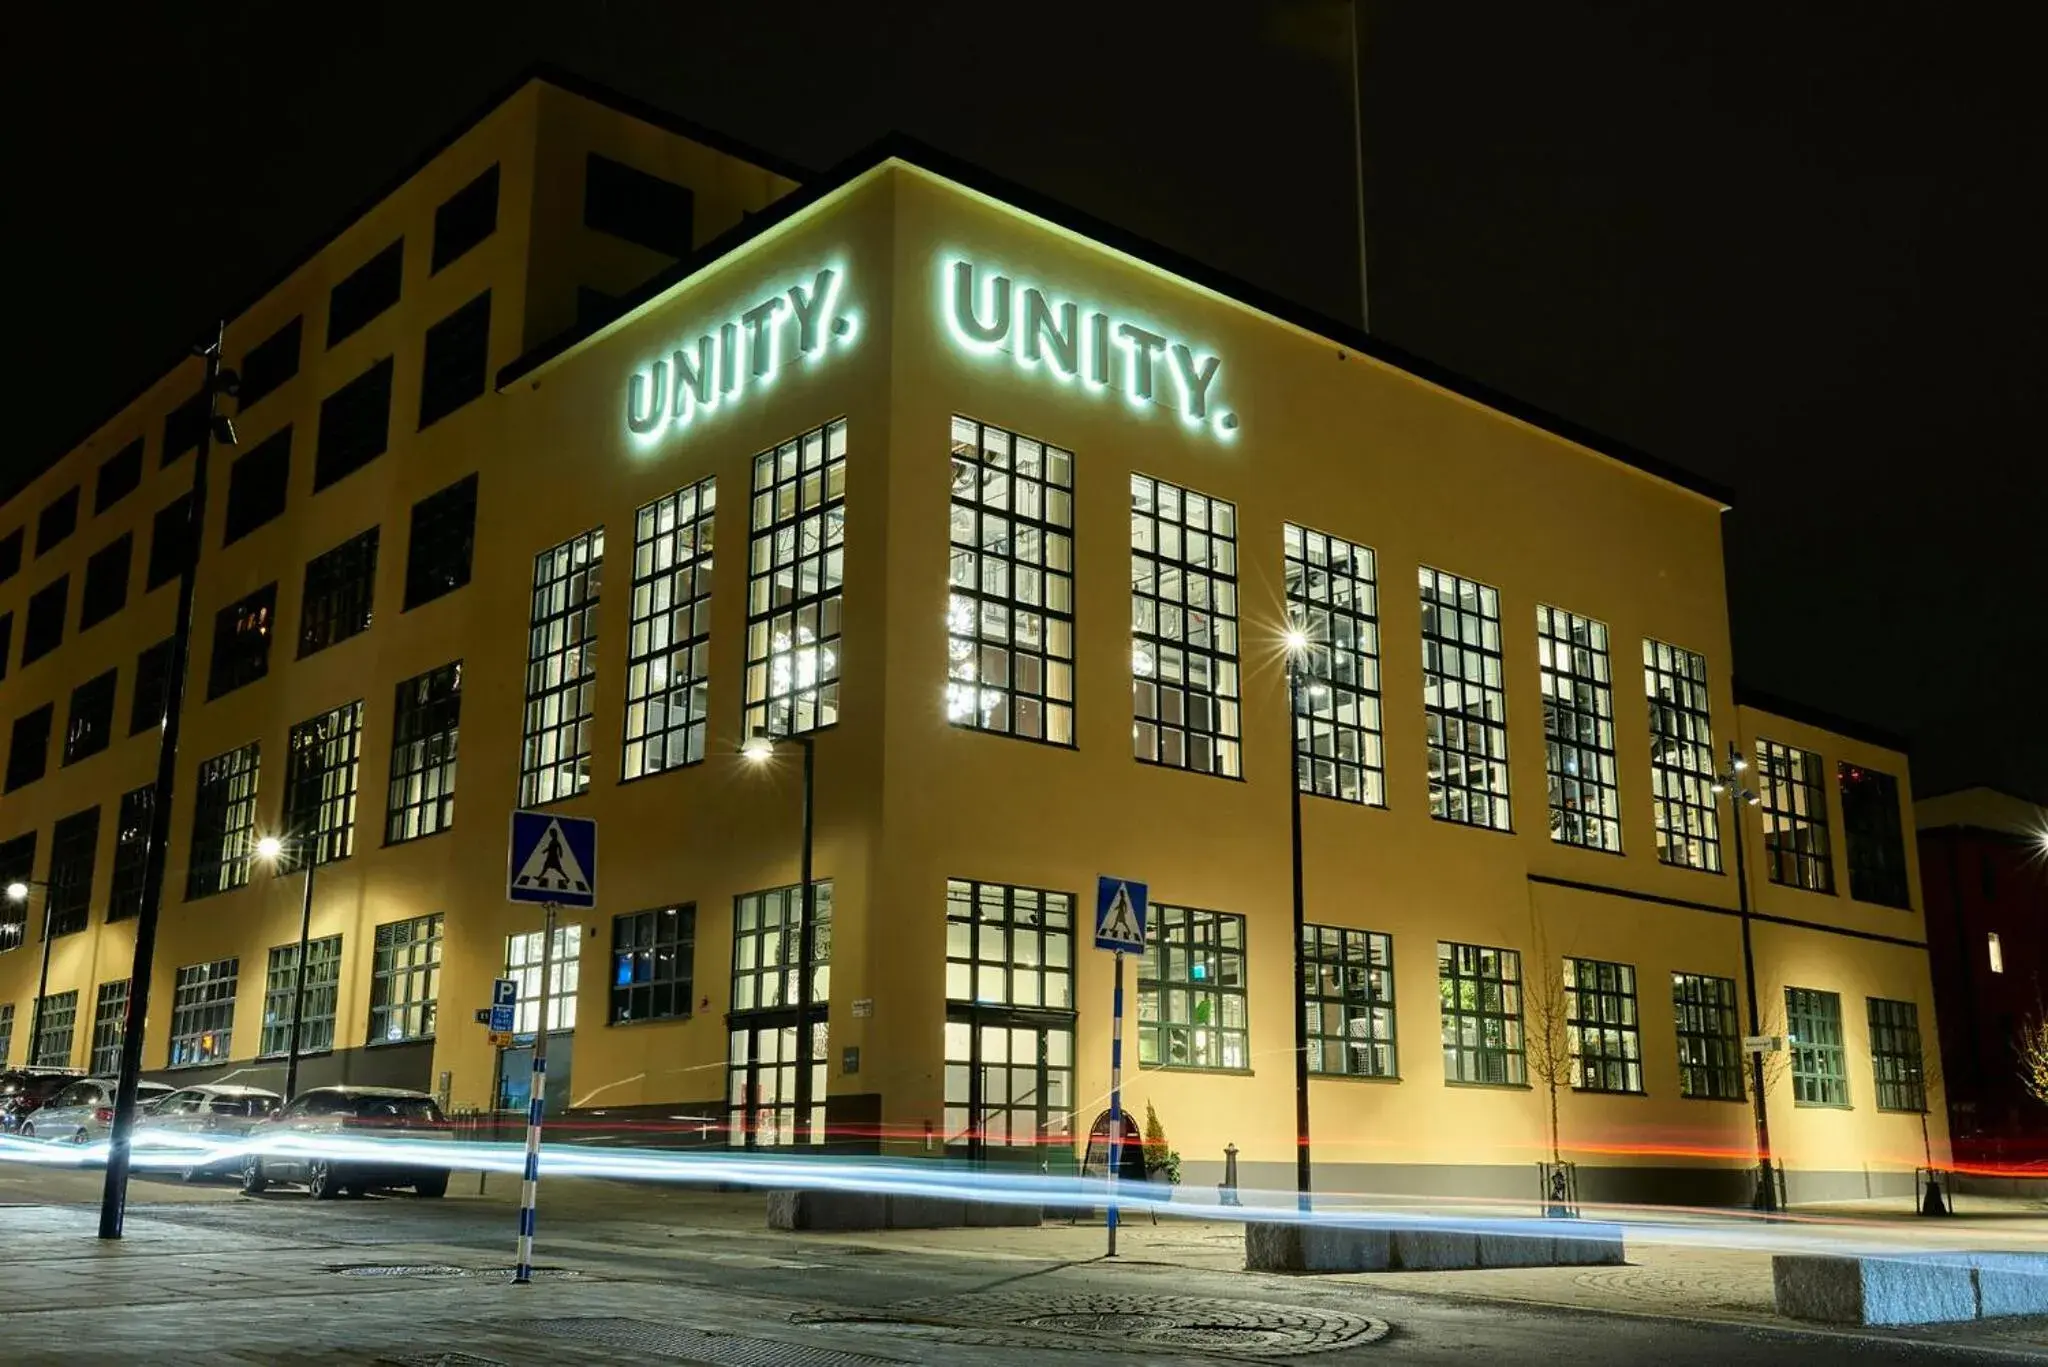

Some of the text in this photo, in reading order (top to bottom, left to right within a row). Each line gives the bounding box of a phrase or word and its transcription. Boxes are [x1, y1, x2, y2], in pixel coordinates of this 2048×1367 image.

[626, 268, 852, 436] UNITY.
[950, 259, 1239, 431] UNITY.
[499, 983, 513, 1003] P
